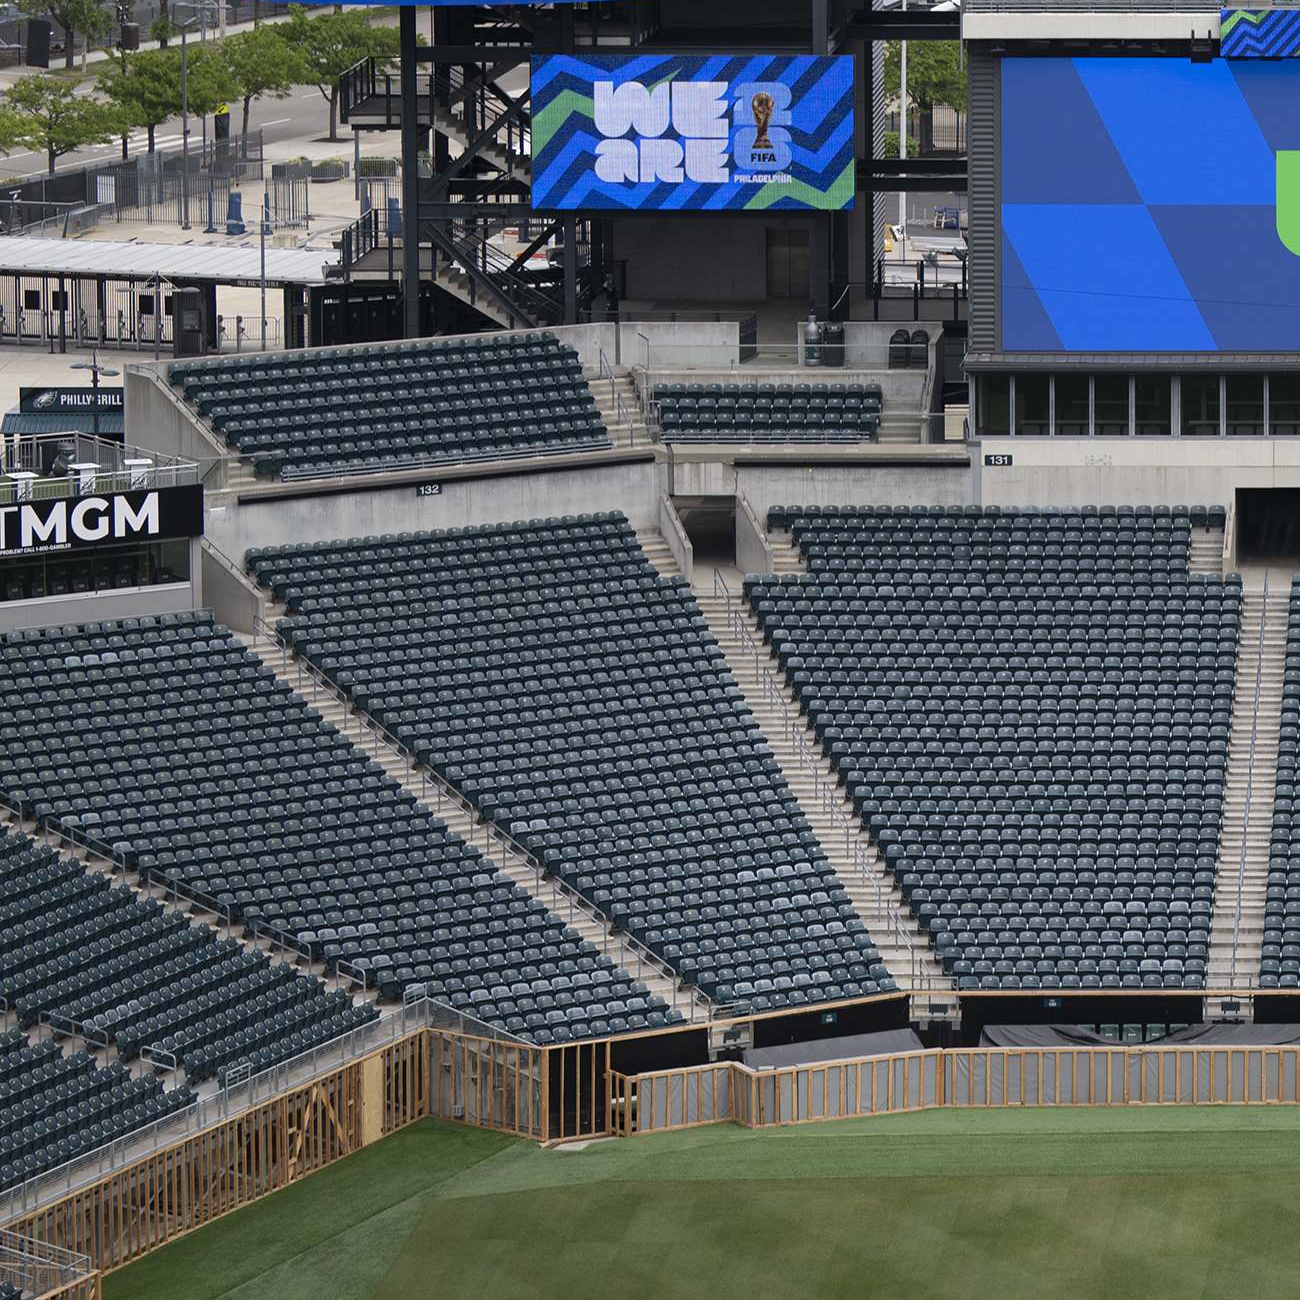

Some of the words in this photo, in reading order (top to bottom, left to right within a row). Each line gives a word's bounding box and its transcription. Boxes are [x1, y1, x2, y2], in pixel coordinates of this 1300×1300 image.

[594, 81, 729, 138] WE
[594, 139, 729, 183] ARE
[751, 153, 777, 162] FIFA
[734, 175, 793, 183] PHILADELPHIA
[989, 456, 1008, 465] 131
[419, 484, 439, 495] 132
[36, 543, 71, 552] 1-800-GAMBLER
